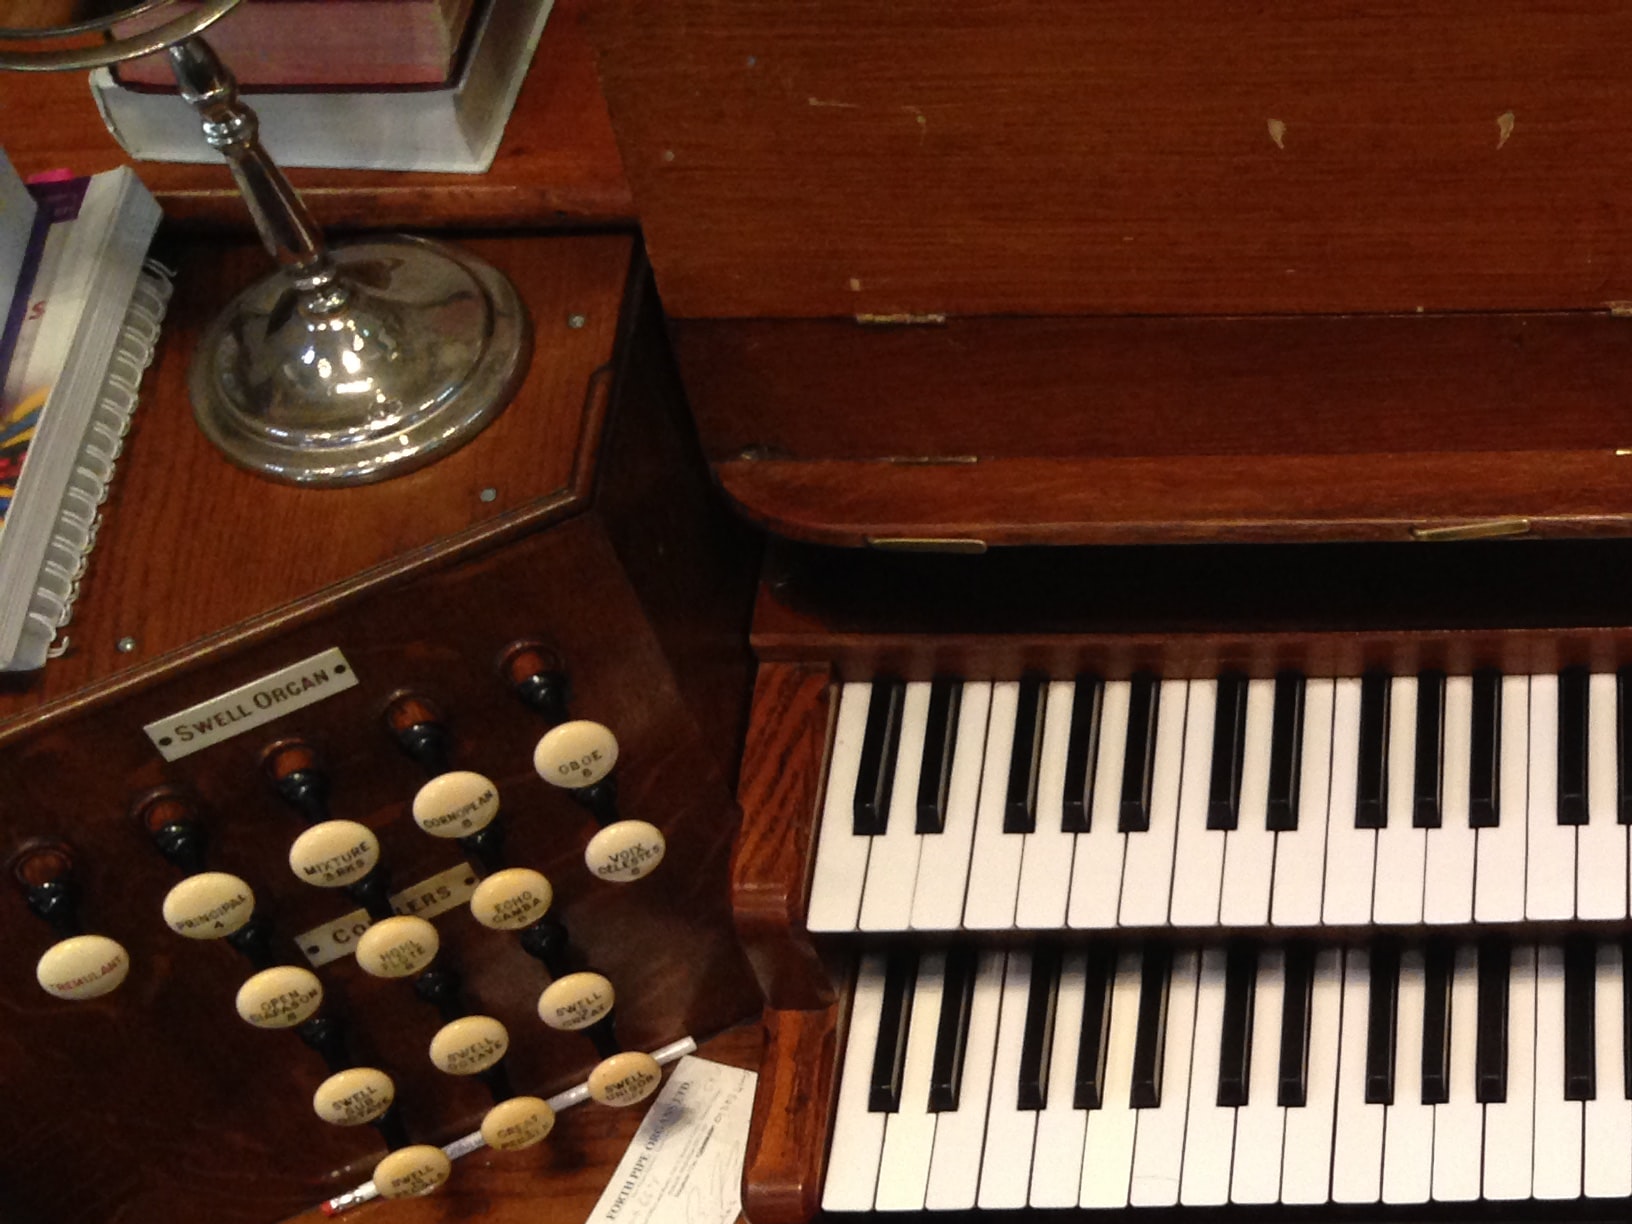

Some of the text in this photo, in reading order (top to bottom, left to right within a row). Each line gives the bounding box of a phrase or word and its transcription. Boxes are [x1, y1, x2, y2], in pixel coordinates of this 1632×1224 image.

[174, 668, 329, 742] SWELL ORGAN
[557, 750, 602, 776] OBOE
[423, 789, 494, 829] CORNOPEAN
[303, 841, 370, 876] MIXTURE
[608, 843, 646, 864] VOIX
[175, 894, 246, 931] PRINCIPAL
[260, 989, 300, 1012] OPEN
[556, 992, 602, 1017] SWELL
[447, 1037, 495, 1062] SWELL
[604, 1070, 648, 1093] SWELL
[332, 1086, 377, 1110] SWELL
[391, 1165, 434, 1187] SWELL
[628, 1150, 652, 1180] PIPE
